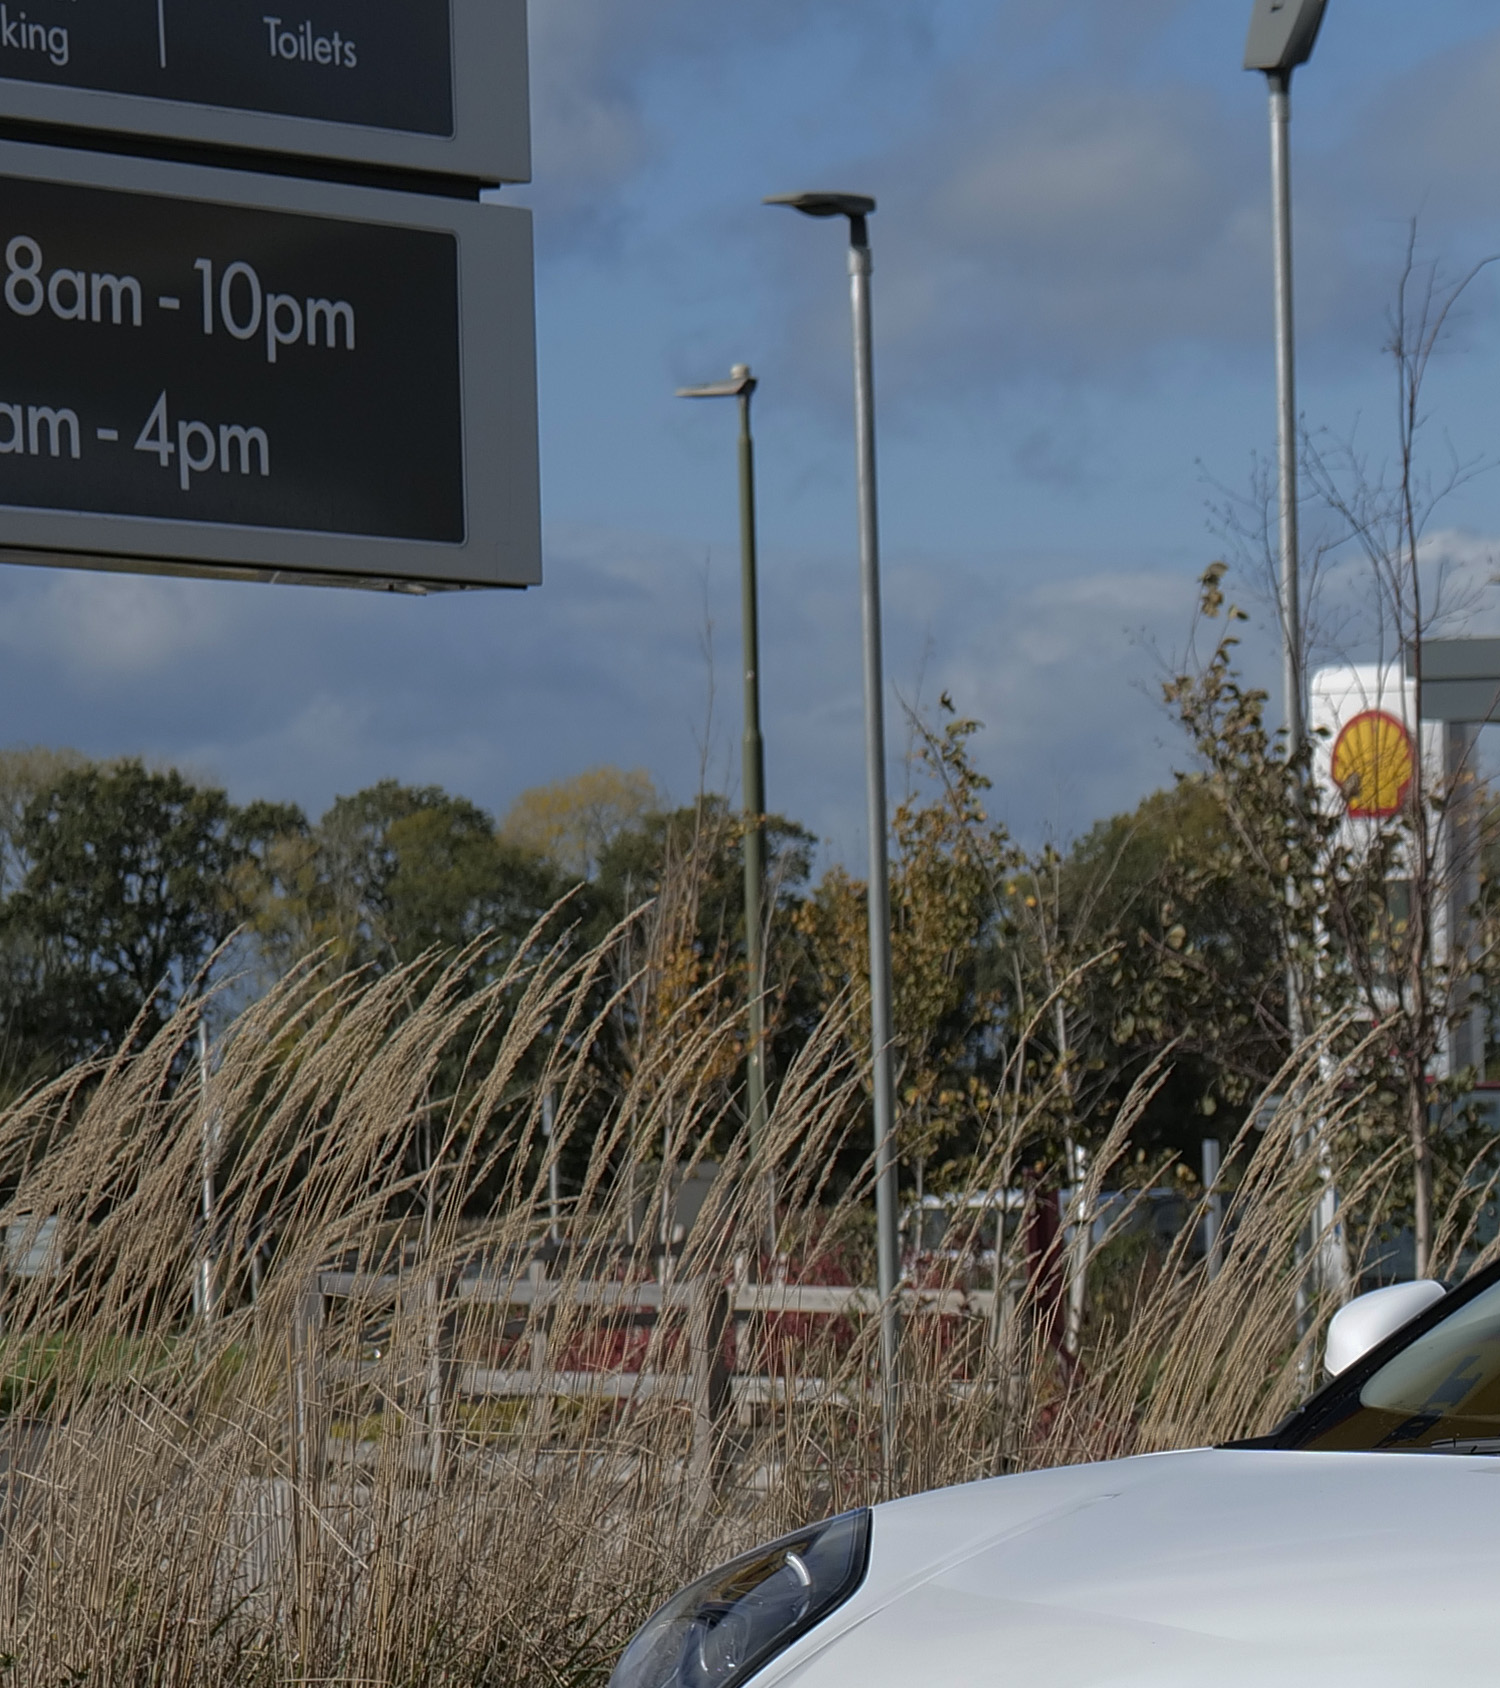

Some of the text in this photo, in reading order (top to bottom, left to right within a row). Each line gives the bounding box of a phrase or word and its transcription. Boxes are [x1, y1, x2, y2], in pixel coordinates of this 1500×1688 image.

[263, 16, 358, 68] Toilets
[4, 235, 143, 327] 8am
[193, 257, 356, 363] 10pm
[133, 390, 270, 491] 4pm
